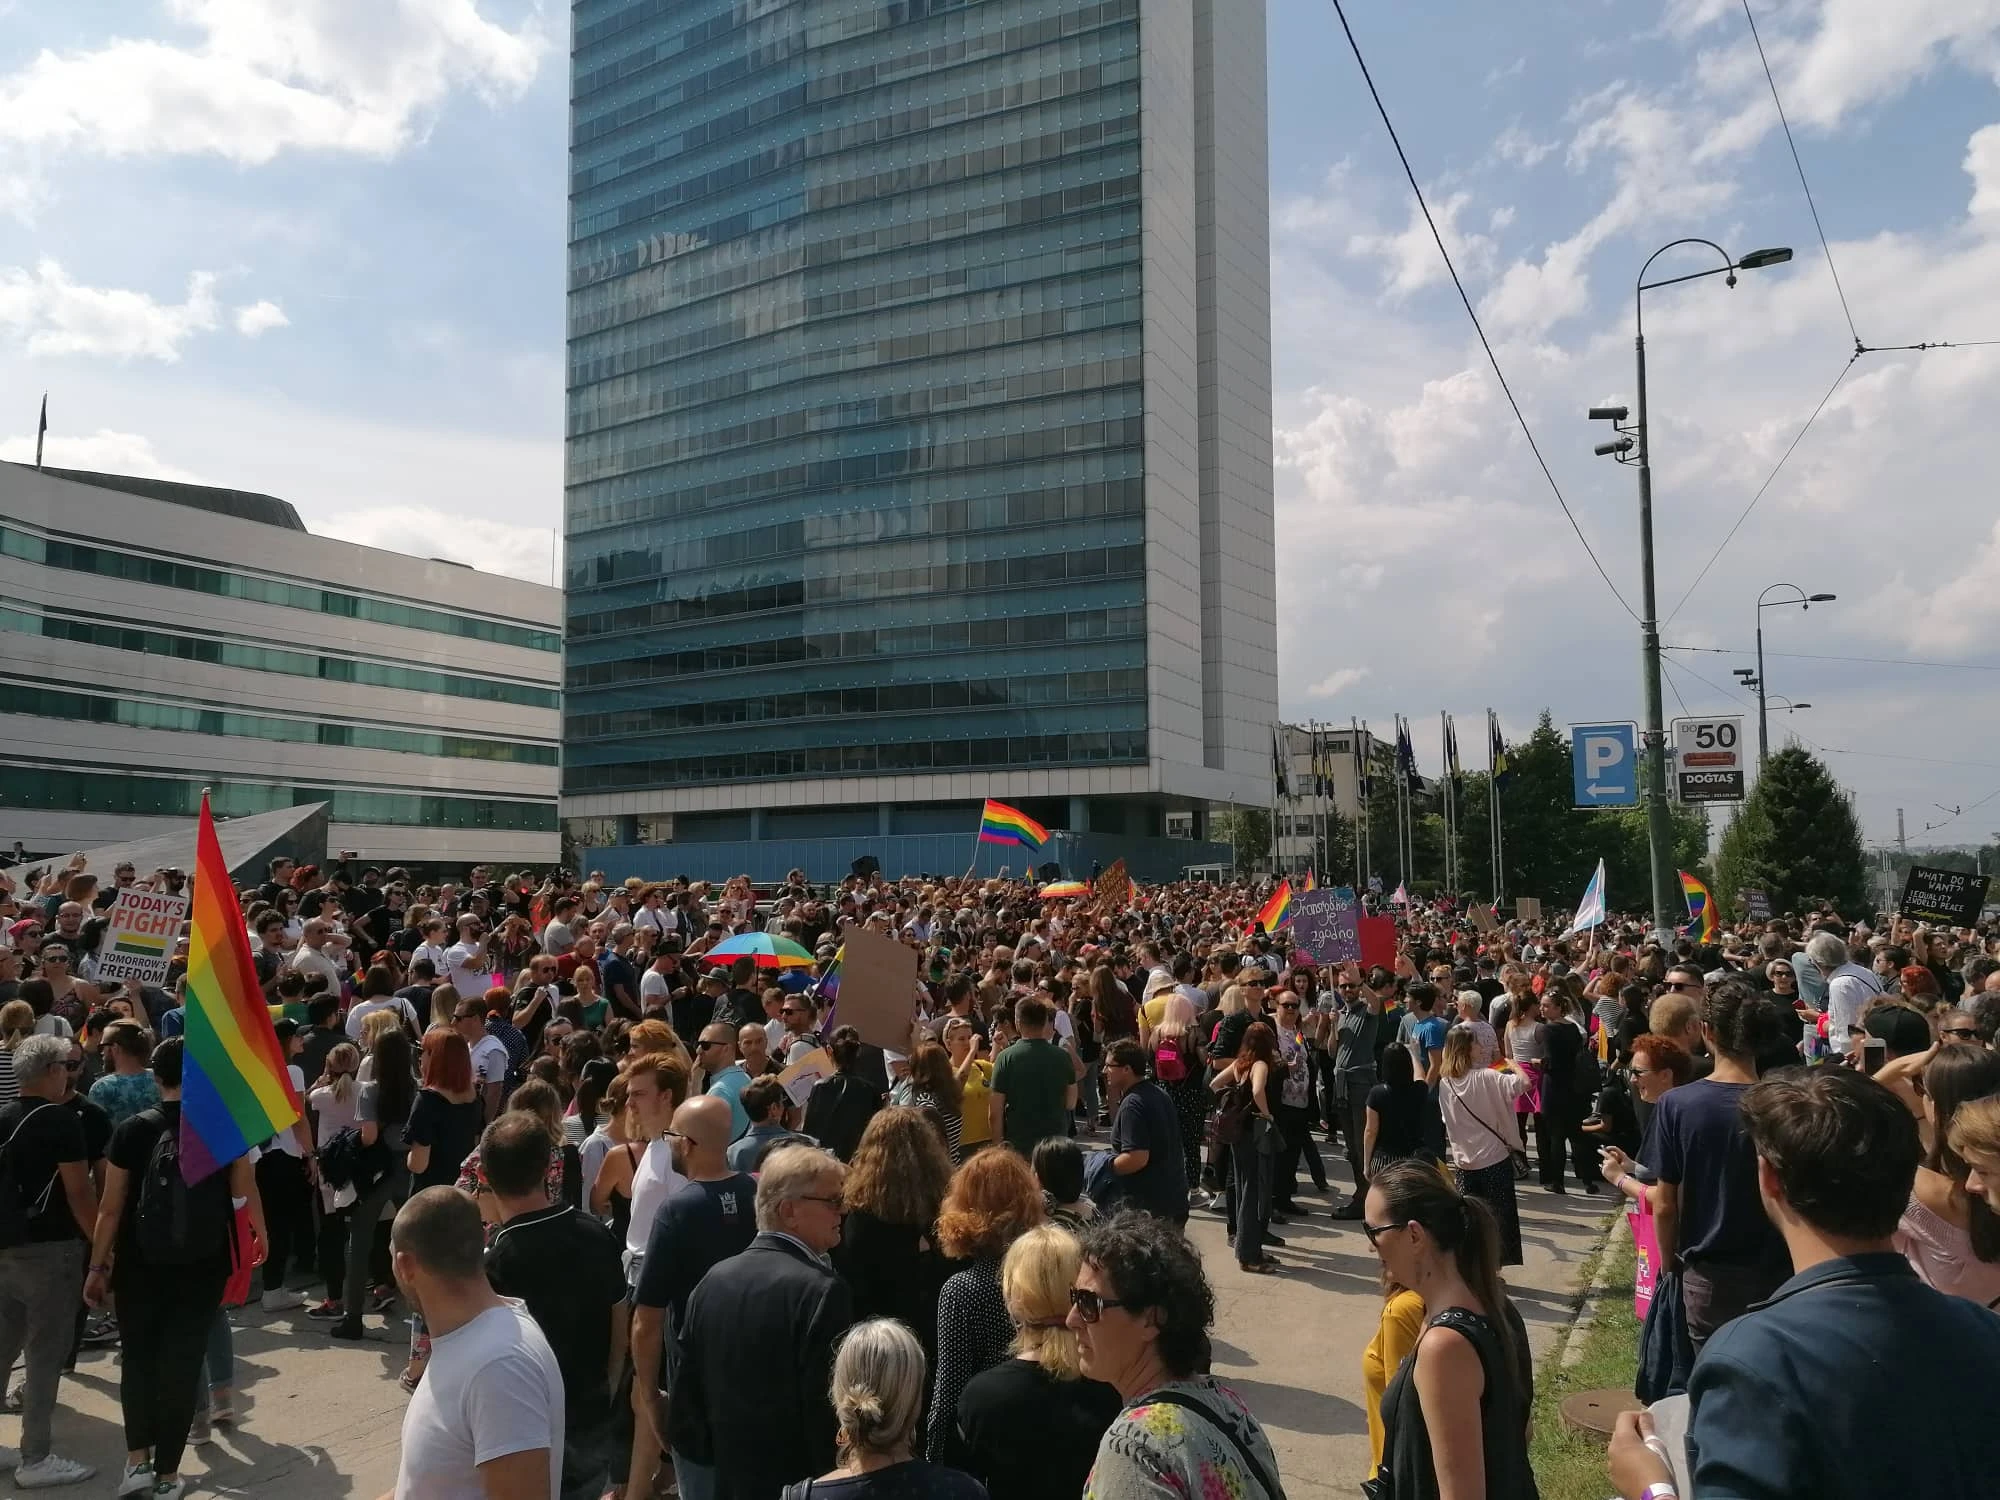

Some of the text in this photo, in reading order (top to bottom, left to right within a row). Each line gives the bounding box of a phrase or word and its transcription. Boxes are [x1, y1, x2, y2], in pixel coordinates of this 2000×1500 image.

[1696, 723, 1737, 749] 50
[1585, 737, 1624, 779] P
[1686, 773, 1734, 785] DOĞTAŞ
[1918, 870, 1982, 888] WHAT DO WE
[120, 893, 185, 915] TODAY'S
[1940, 902, 1965, 912] PEACE
[112, 909, 180, 936] FIGHT
[104, 952, 168, 969] TOMORROW'S
[99, 963, 165, 983] FREEDOM
